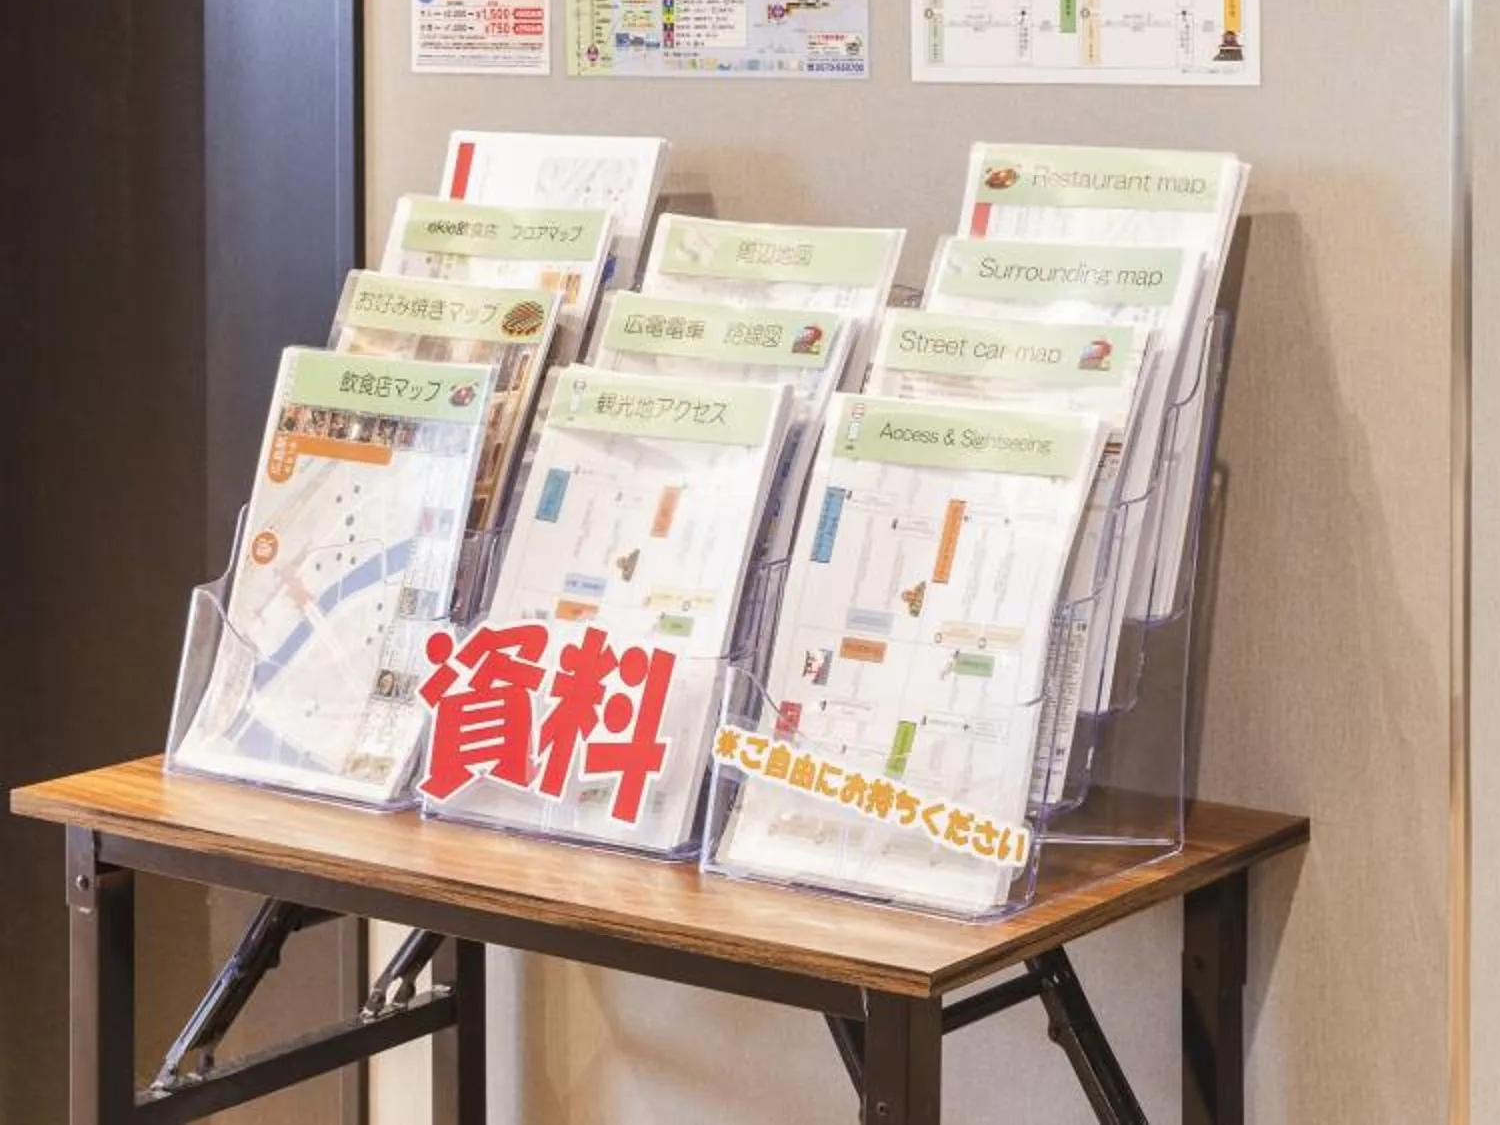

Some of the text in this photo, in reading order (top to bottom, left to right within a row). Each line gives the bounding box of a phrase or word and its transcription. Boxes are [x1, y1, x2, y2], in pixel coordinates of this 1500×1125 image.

[1031, 164, 1207, 195] Restaurant map
[979, 257, 1163, 287] Surrounding map
[354, 290, 501, 325] お好み焼きマップ
[899, 330, 1063, 365] Street car map
[339, 370, 441, 402] 飲食店マップ
[596, 392, 726, 425] 観光地アクセス
[879, 422, 940, 444] Access
[943, 428, 956, 447] &
[420, 624, 677, 825] 資料
